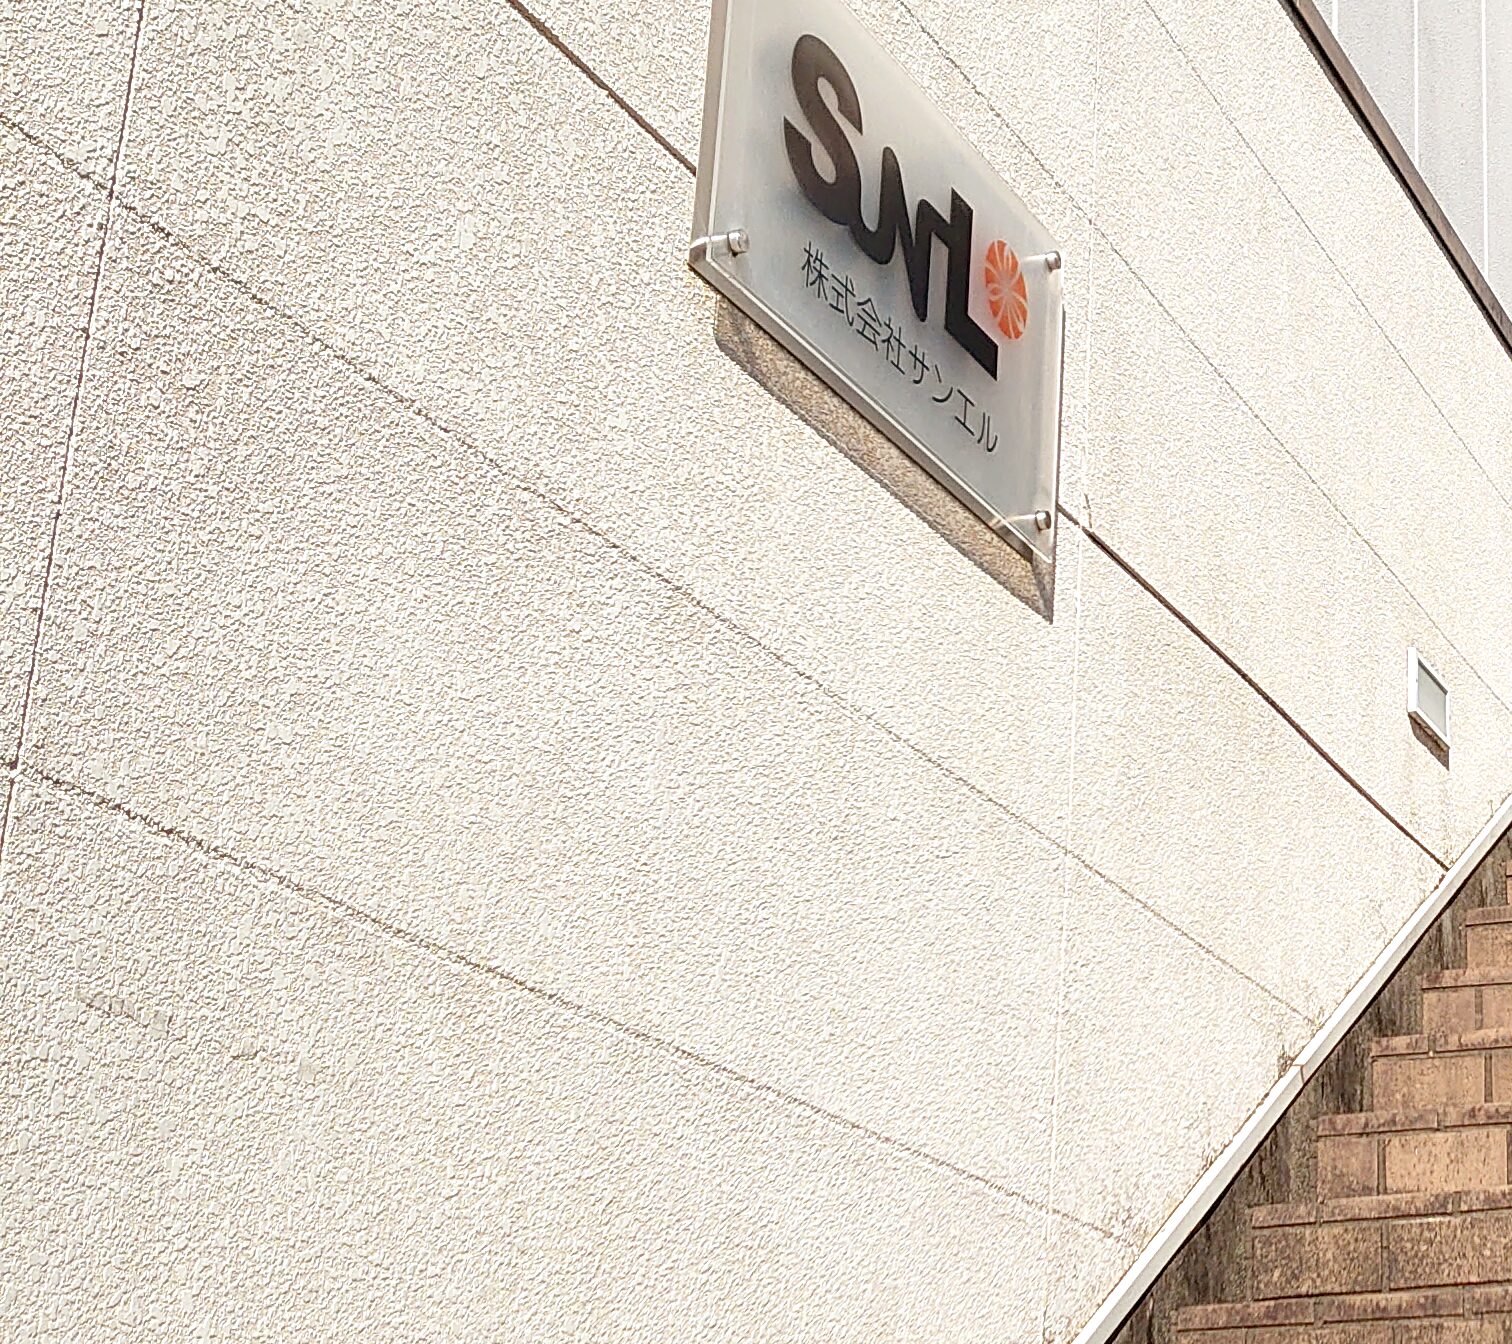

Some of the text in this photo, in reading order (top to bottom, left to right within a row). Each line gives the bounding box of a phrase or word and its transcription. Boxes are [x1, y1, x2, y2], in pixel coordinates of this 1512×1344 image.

[801, 241, 999, 453] 株式会社サンエル
